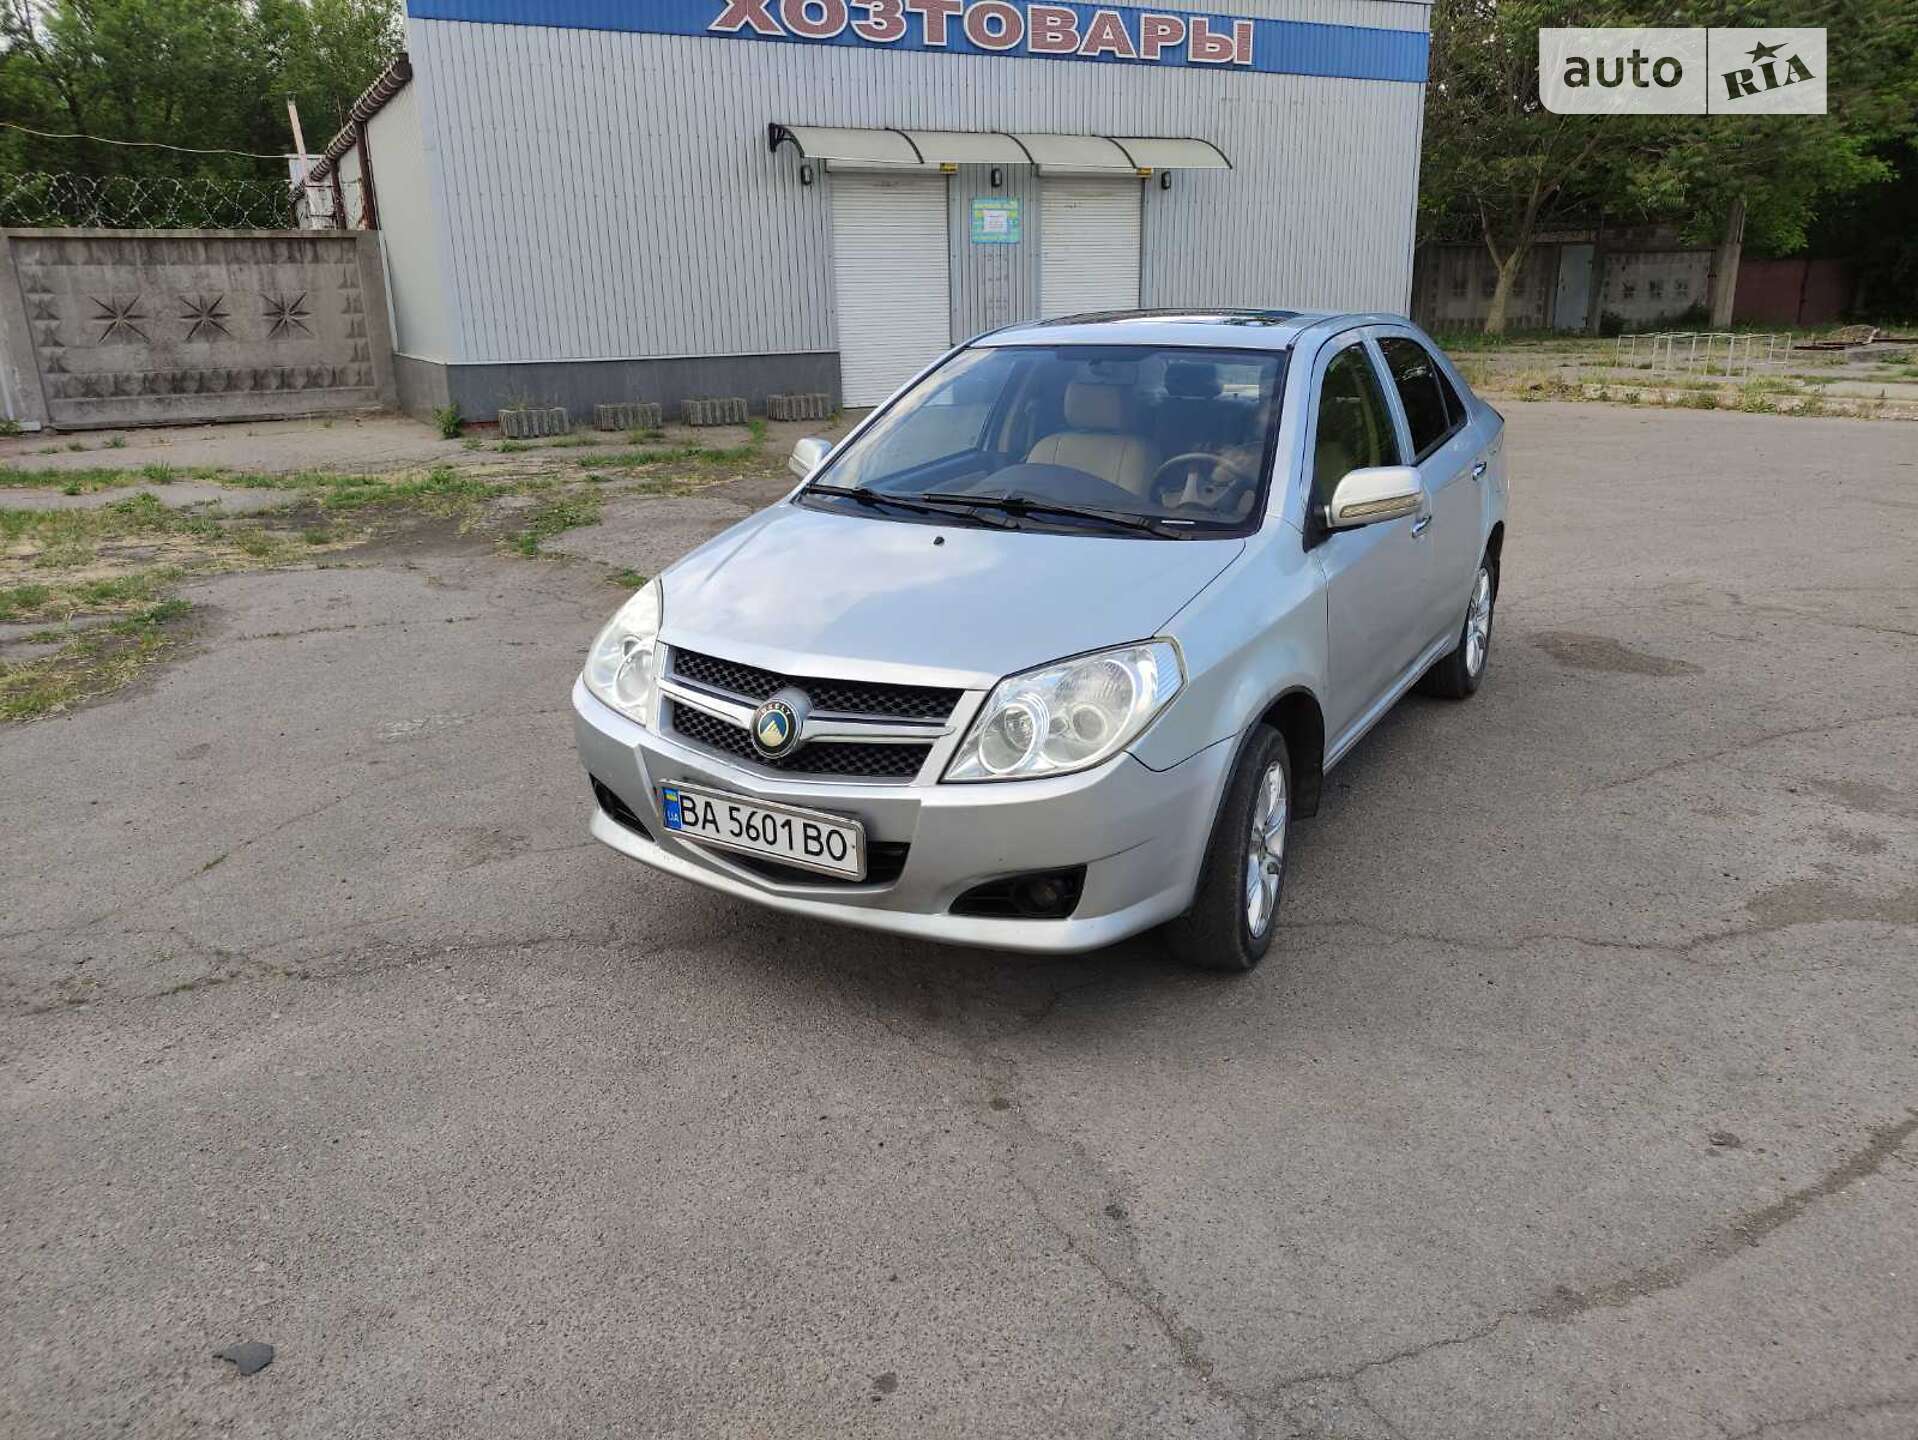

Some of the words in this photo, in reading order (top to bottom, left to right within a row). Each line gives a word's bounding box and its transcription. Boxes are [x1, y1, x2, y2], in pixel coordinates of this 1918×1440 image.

[708, 0, 1255, 66] ХОЗТОВАРЫ
[680, 795, 720, 834] BA
[728, 806, 794, 851] 5601
[802, 821, 848, 862] BO
